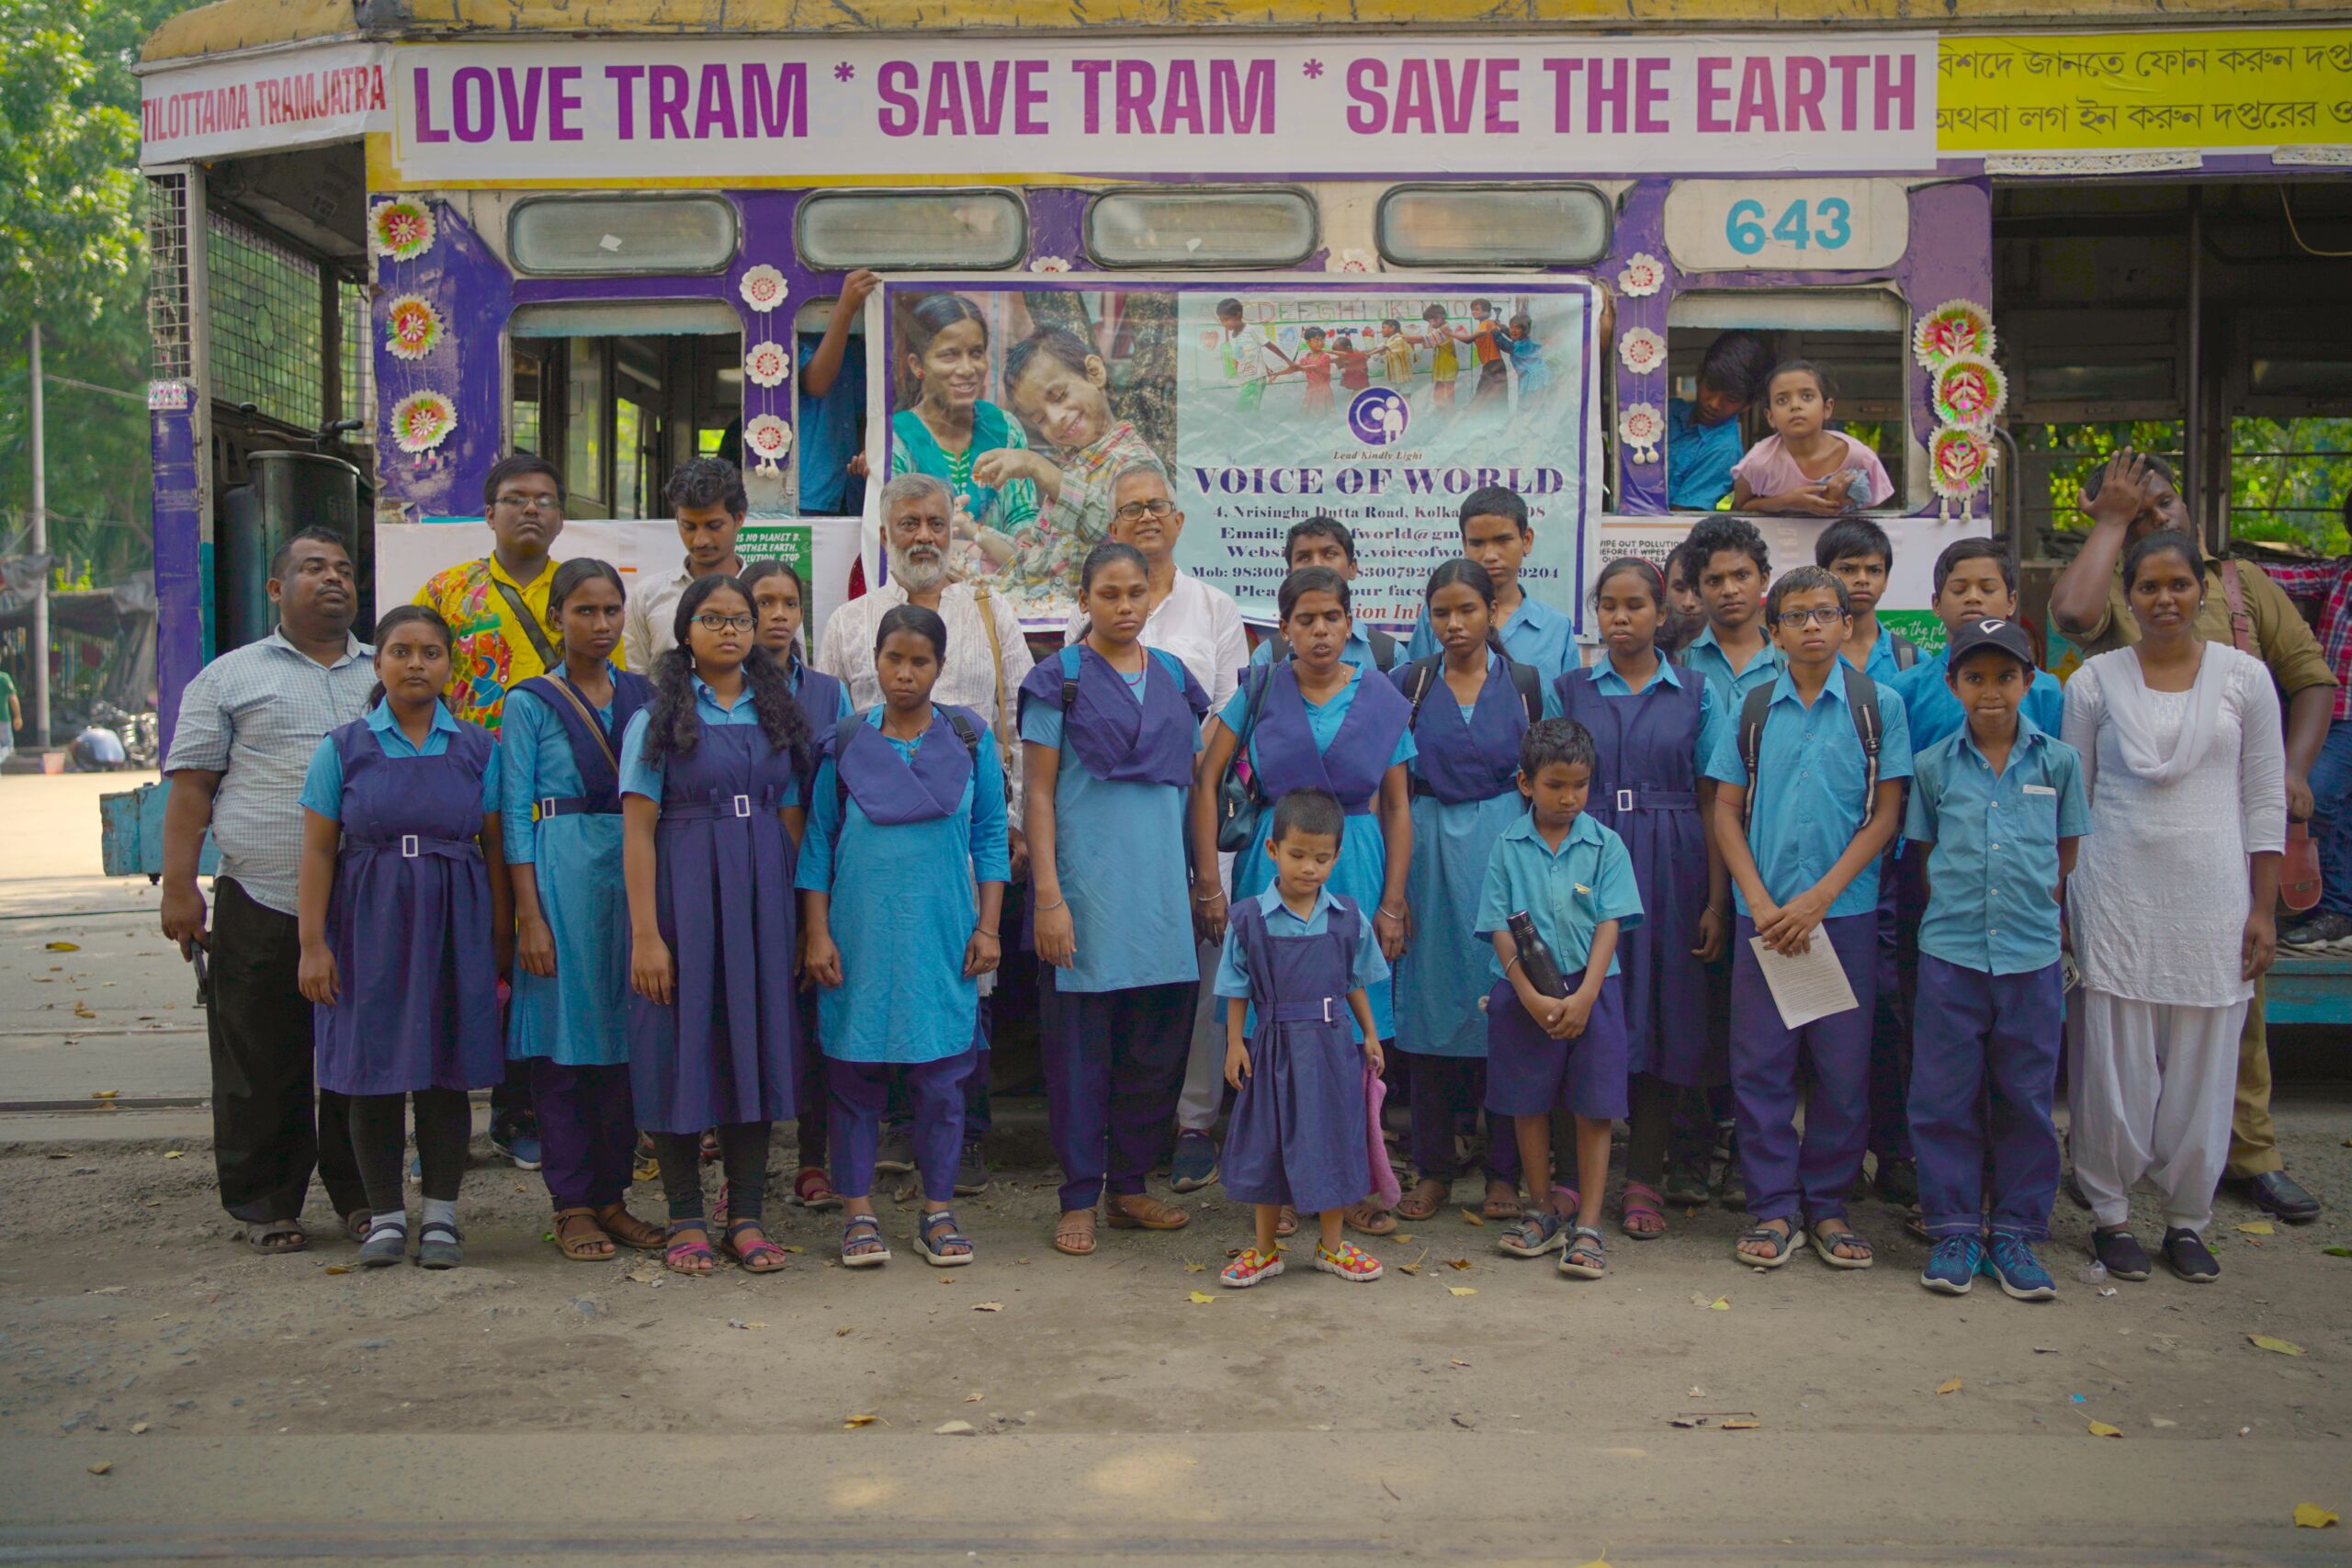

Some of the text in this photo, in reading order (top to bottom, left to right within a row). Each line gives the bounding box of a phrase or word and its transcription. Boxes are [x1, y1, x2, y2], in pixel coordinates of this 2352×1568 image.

[2022, 51, 2127, 77] জানতে
[2136, 47, 2209, 77] ফোন
[2216, 47, 2295, 73] করুন
[141, 64, 386, 143] TILOTTAMA TRAMJATRA
[413, 53, 1916, 143] LOVE TRAM SAVE TRAM SAVE THE EARTH
[2017, 104, 2070, 132] লগ
[2075, 95, 2119, 135] ইন
[2126, 104, 2204, 130] করুন
[2211, 98, 2320, 130] দপ্তরের
[1724, 197, 1852, 255] 643
[1333, 450, 1423, 462] Lead Kindly Light
[1192, 467, 1564, 494] VOICE OF WORLD
[1213, 506, 1228, 518] 4,
[1234, 506, 1309, 519] Nrisingha
[1315, 506, 1359, 518] Dutta
[1365, 506, 1408, 519] Road,
[736, 533, 801, 542] IS NO PLANET B.
[1220, 527, 1460, 542] Email: fworld@gm
[734, 543, 797, 552] MOTHER EARTH.
[779, 553, 800, 562] STOP
[1192, 567, 1228, 578] Mob:
[1350, 589, 1383, 597] our
[1355, 603, 1387, 619] ion
[1886, 624, 1908, 636] ave
[1907, 620, 1929, 637] the
